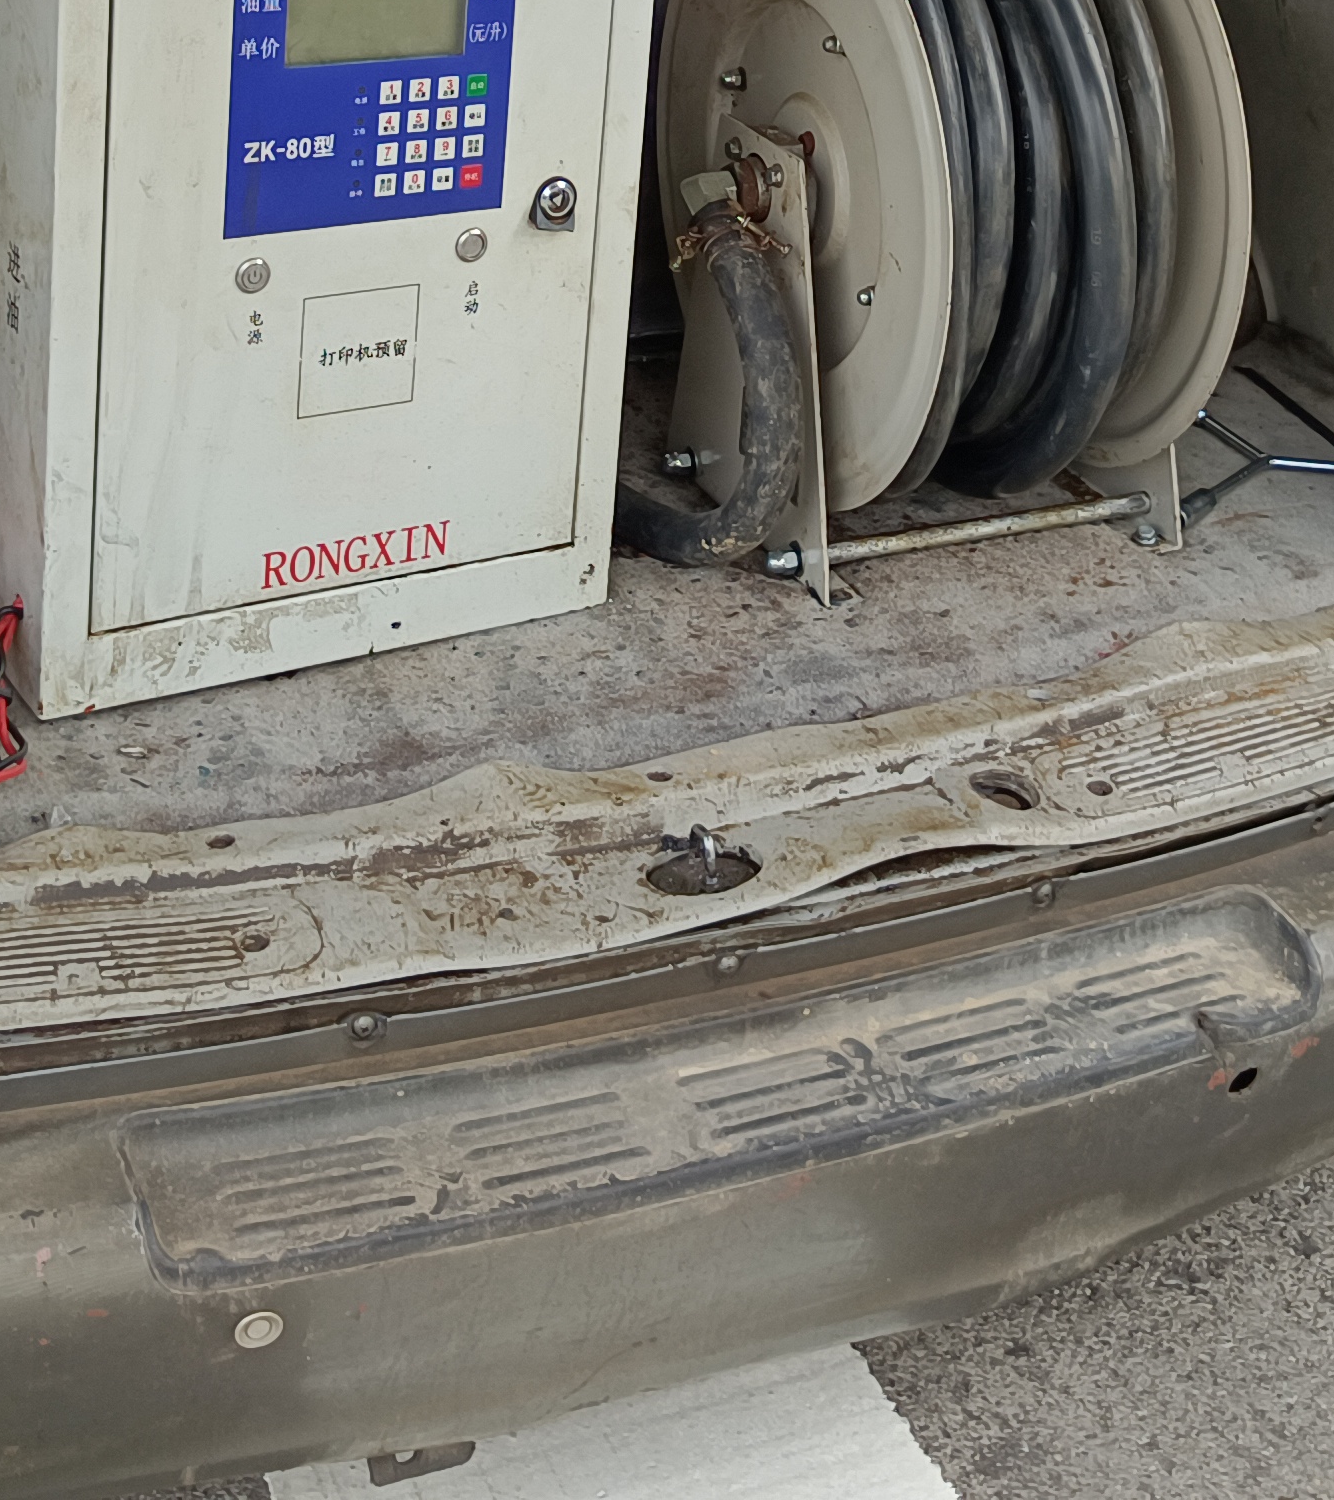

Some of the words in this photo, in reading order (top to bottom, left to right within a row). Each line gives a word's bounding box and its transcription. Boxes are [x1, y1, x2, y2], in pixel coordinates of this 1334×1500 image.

[469, 20, 507, 43] (元/升)
[238, 36, 281, 60] 单价
[243, 133, 335, 163] ZK-80型
[464, 280, 480, 315] 启动
[247, 310, 264, 345] 电源
[317, 338, 408, 367] 打印机预留
[260, 520, 451, 590] RONGXIN
